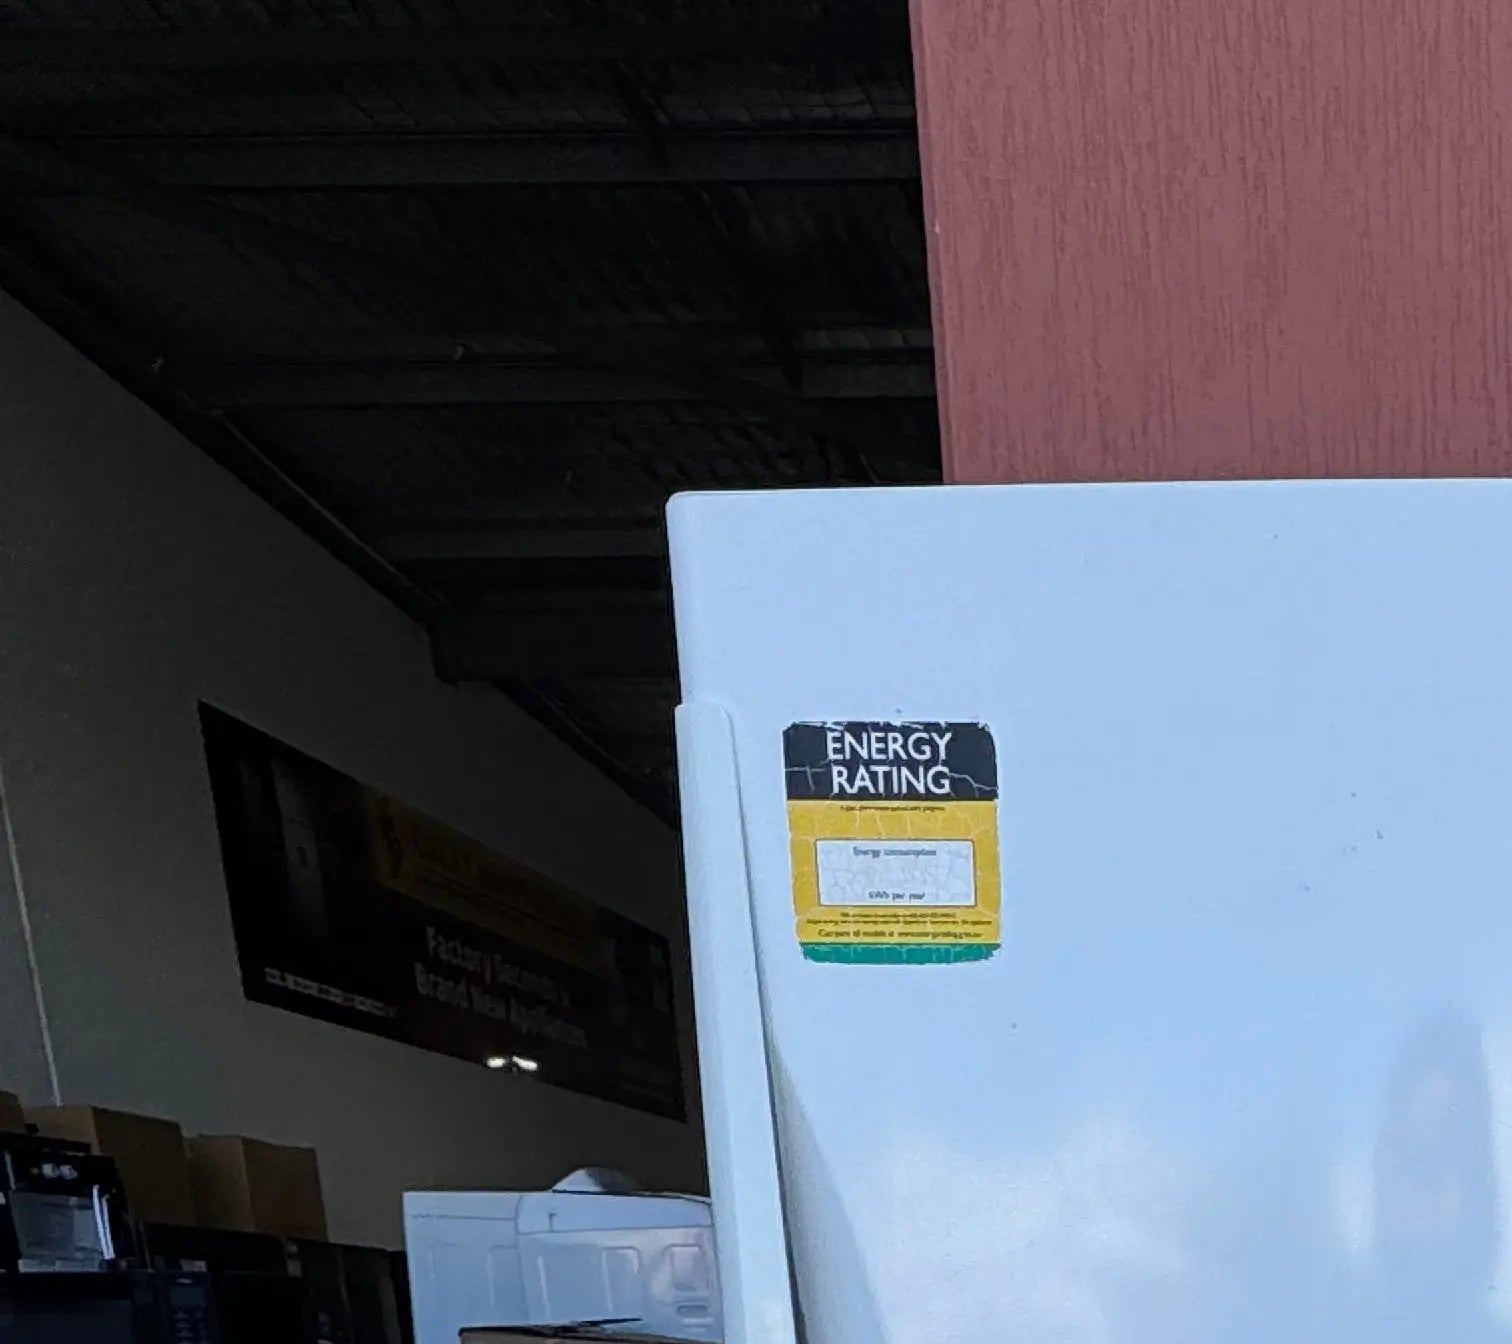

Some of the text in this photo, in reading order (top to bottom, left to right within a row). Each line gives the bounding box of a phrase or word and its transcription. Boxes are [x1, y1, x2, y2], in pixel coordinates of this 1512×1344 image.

[826, 731, 952, 761] ENERGY
[831, 765, 951, 794] RATING
[414, 961, 469, 1009] Brand
